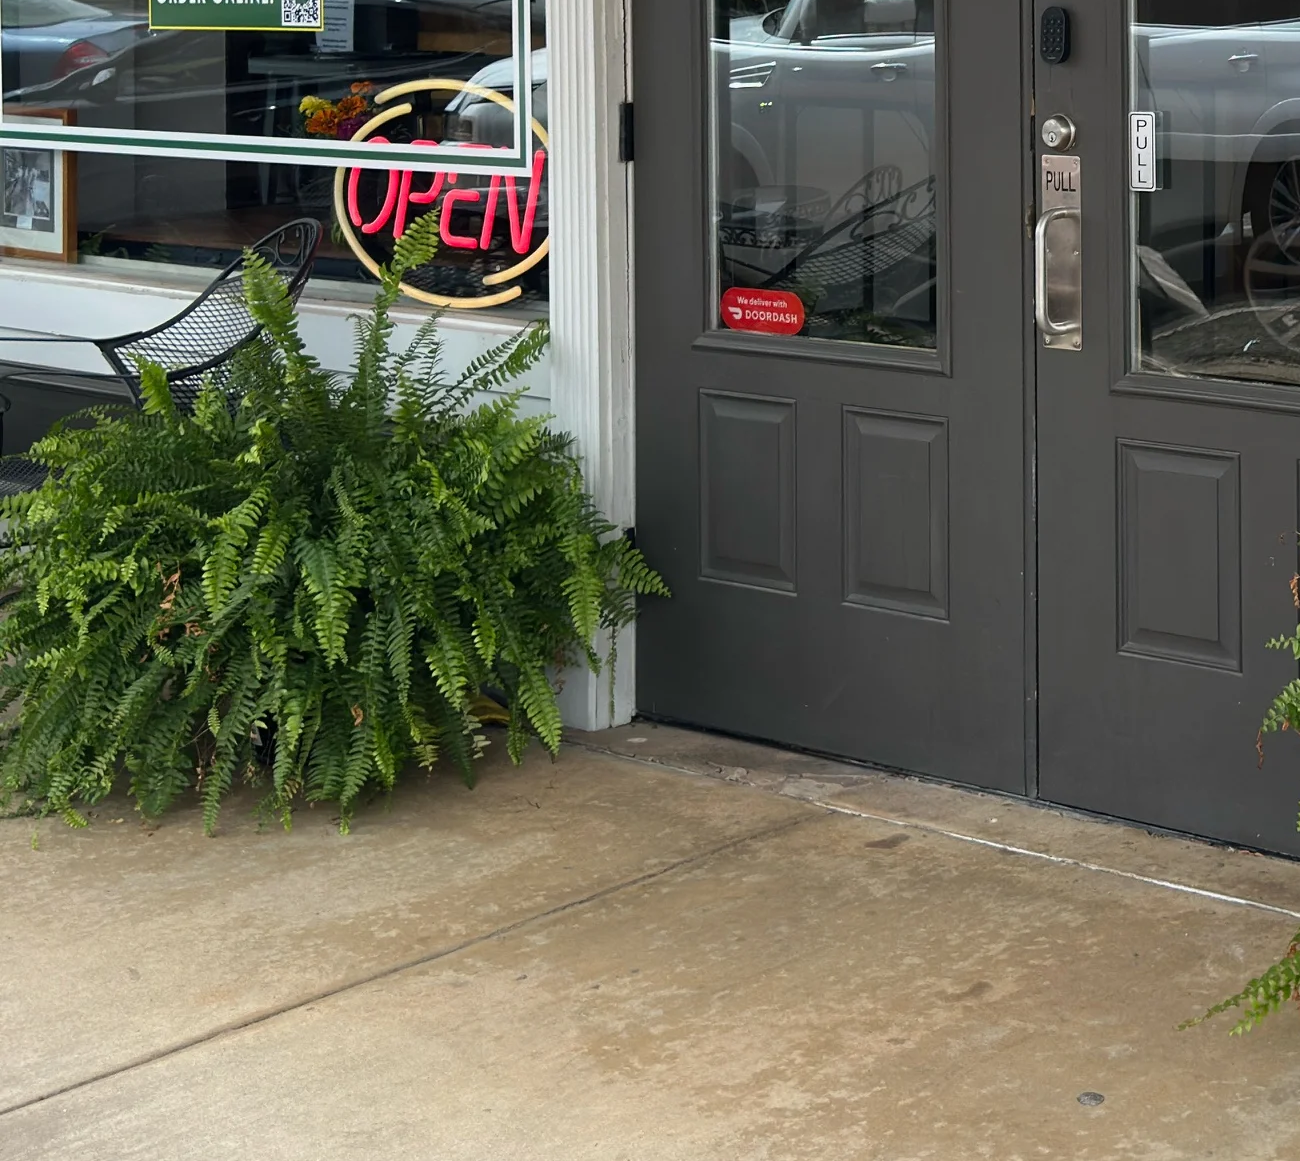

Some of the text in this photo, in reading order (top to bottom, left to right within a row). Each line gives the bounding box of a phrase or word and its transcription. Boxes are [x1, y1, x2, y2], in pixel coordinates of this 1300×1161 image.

[1136, 119, 1148, 184] PULL
[1046, 170, 1077, 193] PULL
[348, 136, 545, 254] OPEN
[737, 296, 788, 308] We deliver with
[745, 310, 798, 324] DOORDASH
